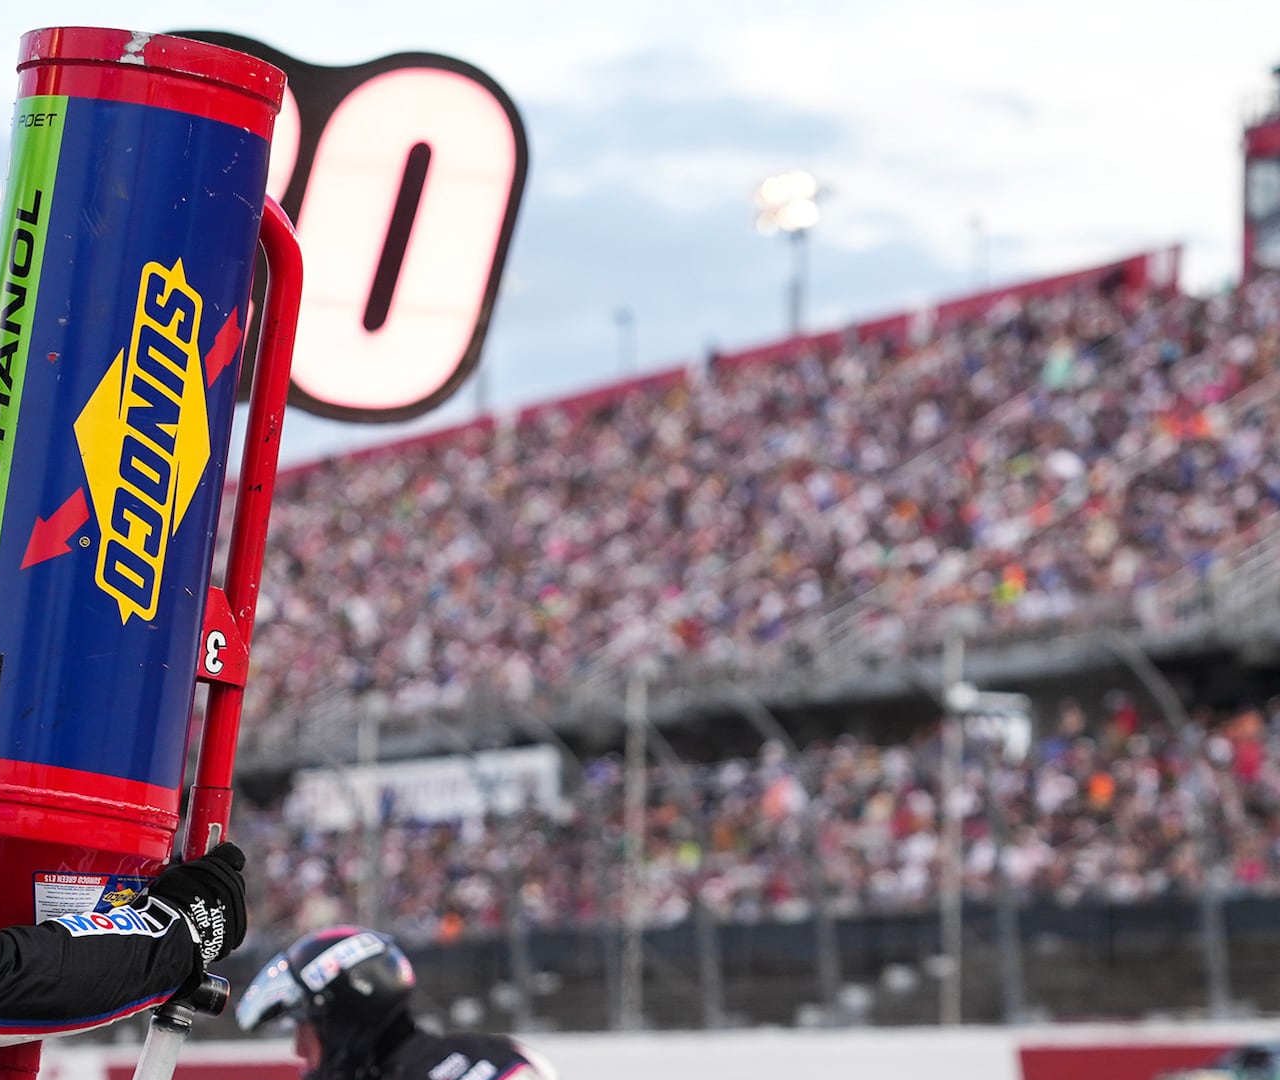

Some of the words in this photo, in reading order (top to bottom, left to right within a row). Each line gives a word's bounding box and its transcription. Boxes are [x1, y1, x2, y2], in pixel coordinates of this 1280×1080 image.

[103, 271, 196, 611] SUNOCO
[205, 630, 227, 675] 3
[56, 907, 148, 932] Mobil
